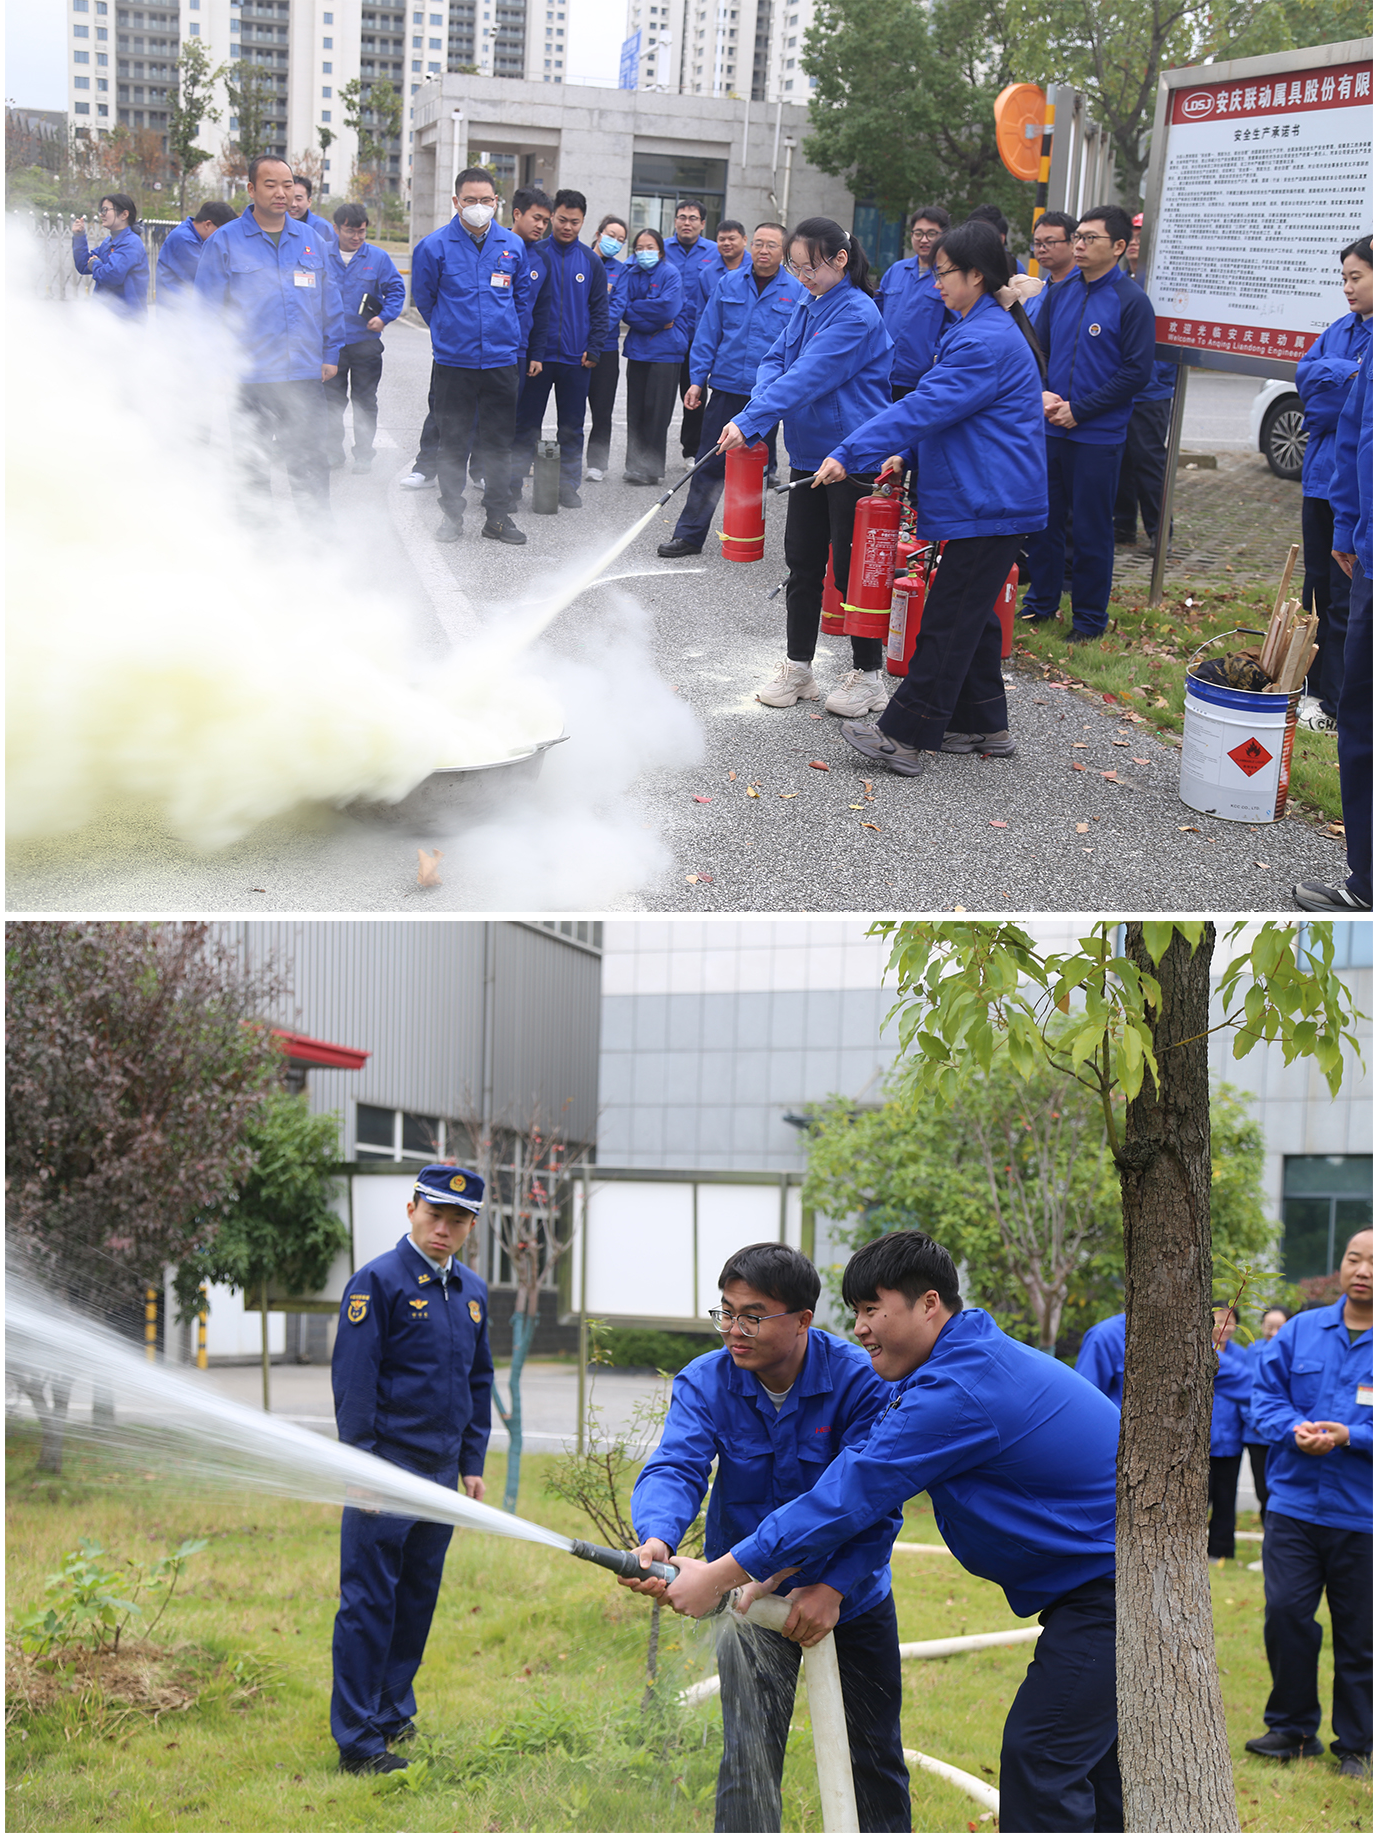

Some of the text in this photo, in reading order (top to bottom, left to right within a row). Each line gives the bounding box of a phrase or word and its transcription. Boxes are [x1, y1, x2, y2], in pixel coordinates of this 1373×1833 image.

[1216, 71, 1371, 114] 安庆联动属具股份有限
[1184, 98, 1212, 112] LDSJ
[1234, 124, 1301, 142] 安全生产承诺书
[1167, 333, 1195, 344] Welcome
[1197, 337, 1206, 345] To
[1207, 338, 1231, 350] Anqing
[1233, 341, 1265, 354] Liandong
